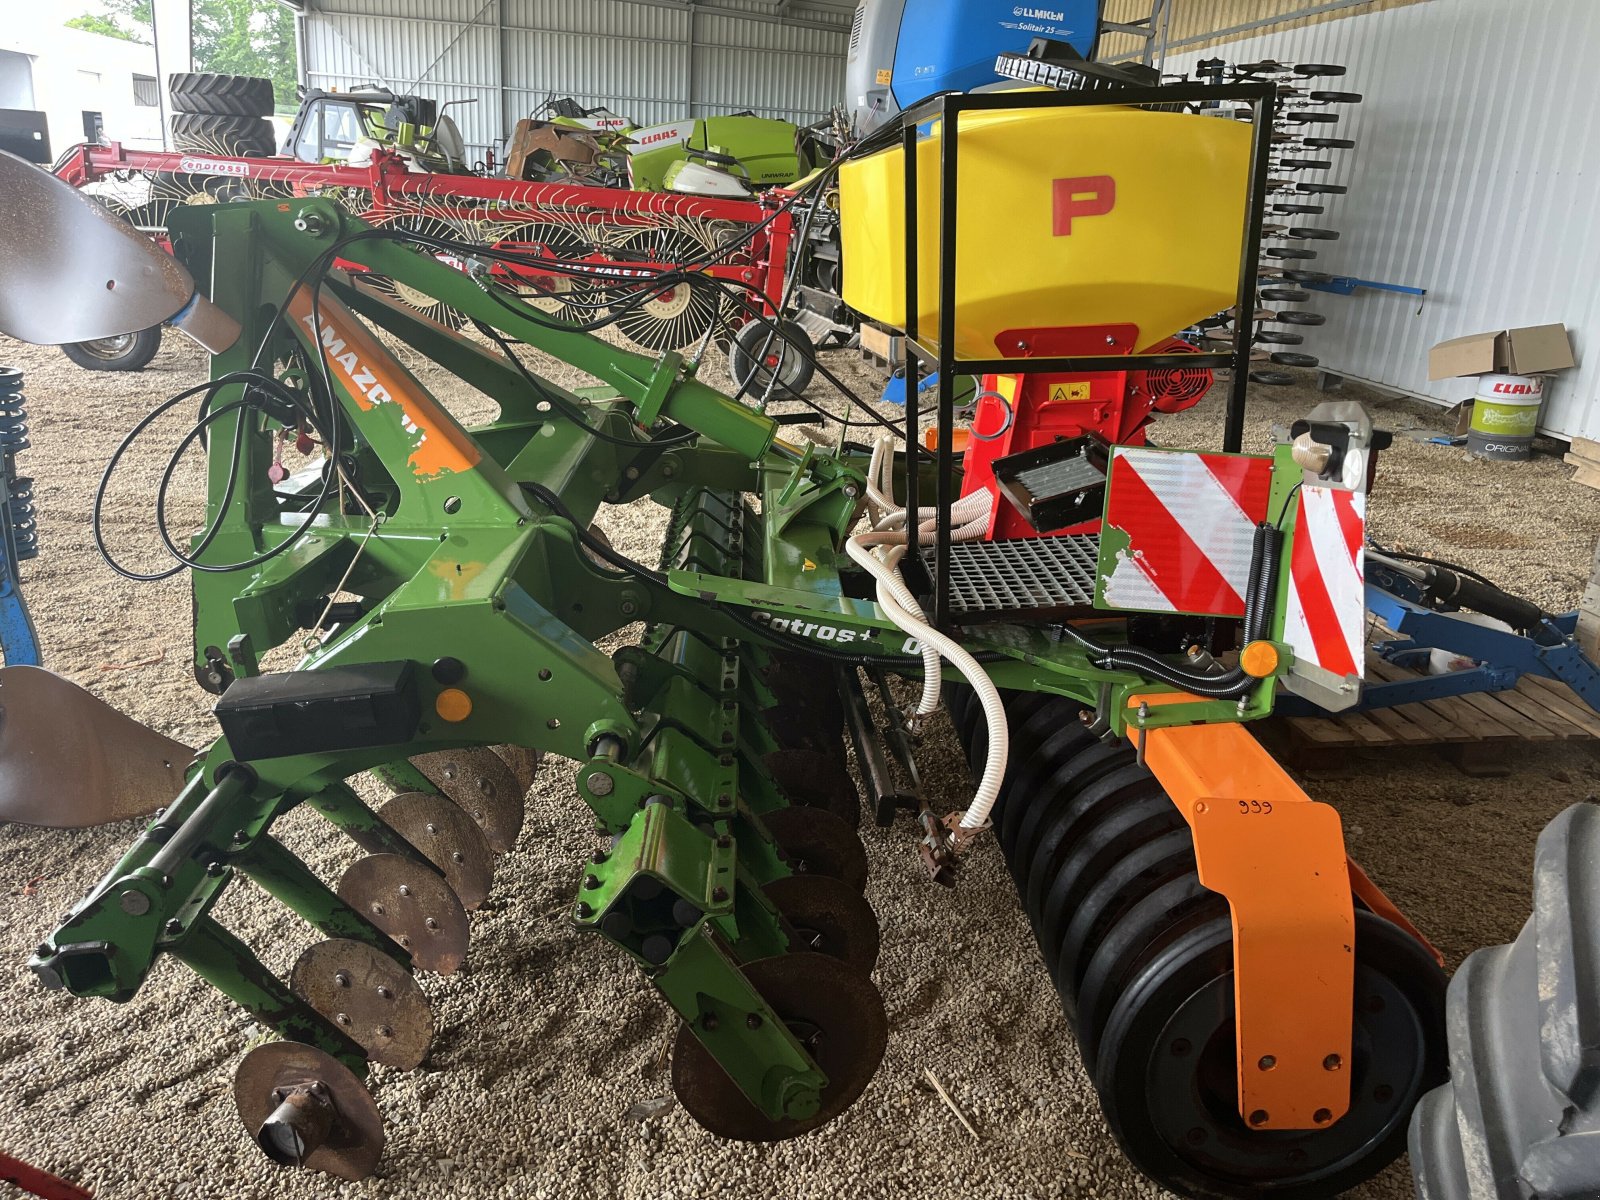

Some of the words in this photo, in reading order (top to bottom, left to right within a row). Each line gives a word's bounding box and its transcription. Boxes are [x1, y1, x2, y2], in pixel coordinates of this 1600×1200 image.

[1017, 22, 1045, 33] Solitair
[1045, 26, 1055, 34] 25
[596, 119, 624, 127] CLAAS
[641, 129, 678, 145] CLAAS
[187, 161, 247, 174] enorossi
[761, 171, 795, 179] UNIWRAP
[1052, 175, 1116, 237] P
[1238, 800, 1273, 815] 999
